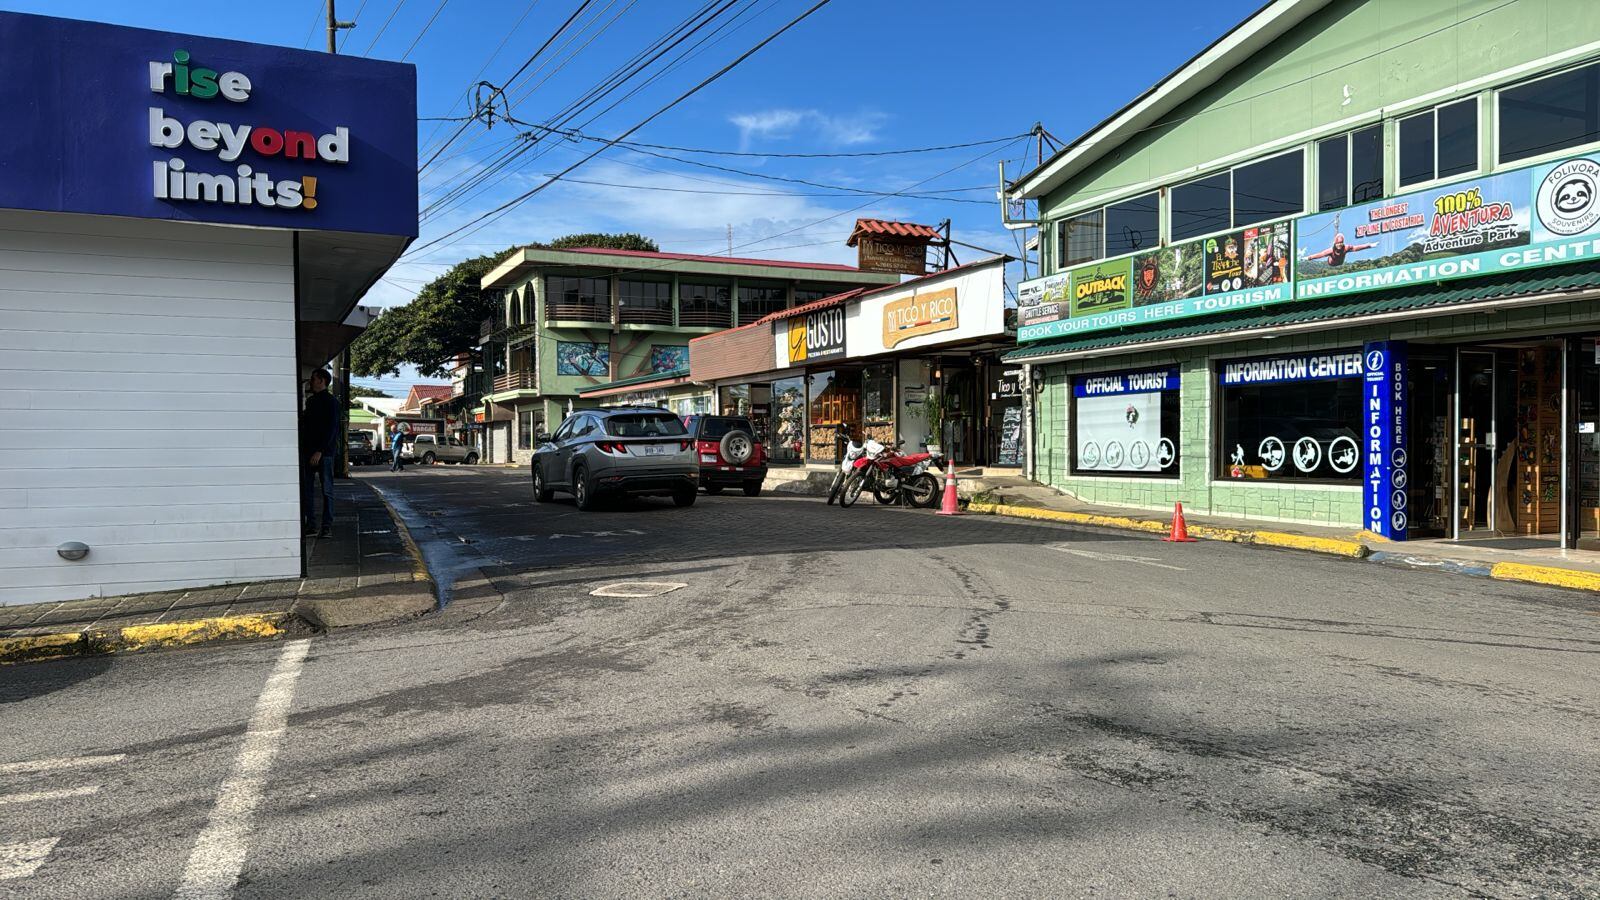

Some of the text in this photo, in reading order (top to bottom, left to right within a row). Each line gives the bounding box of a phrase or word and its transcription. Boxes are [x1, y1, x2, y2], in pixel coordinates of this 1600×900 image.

[149, 50, 251, 102] rise
[149, 107, 349, 163] beyond
[153, 158, 318, 209] limits!
[1548, 163, 1600, 184] FOLIVORA
[1371, 203, 1408, 219] THE LONGEST
[1435, 188, 1481, 215] 100%
[1391, 216, 1409, 230] COSTA
[1410, 214, 1424, 226] RICA
[1430, 203, 1513, 236] AVENTURA
[1552, 212, 1594, 227] SOUVENIRS
[1424, 228, 1517, 252] Adventure Park
[1077, 275, 1125, 298] OUTBACK
[1300, 258, 1480, 296] INFORMATION
[898, 297, 953, 323] TICO Y RICO
[1021, 326, 1052, 339] BOOK
[1057, 320, 1089, 332] YOUR
[1090, 311, 1137, 327] TOURS
[1144, 303, 1185, 319] HERE
[1193, 288, 1281, 310] TOURISM
[1025, 303, 1059, 319] SHUTTLE SERVICE
[807, 308, 843, 349] GUSTO
[1225, 353, 1363, 383] INFORMATION CENTER
[1085, 372, 1168, 394] OFFICIAL TOURIST
[1370, 385, 1382, 533] INFORMATION
